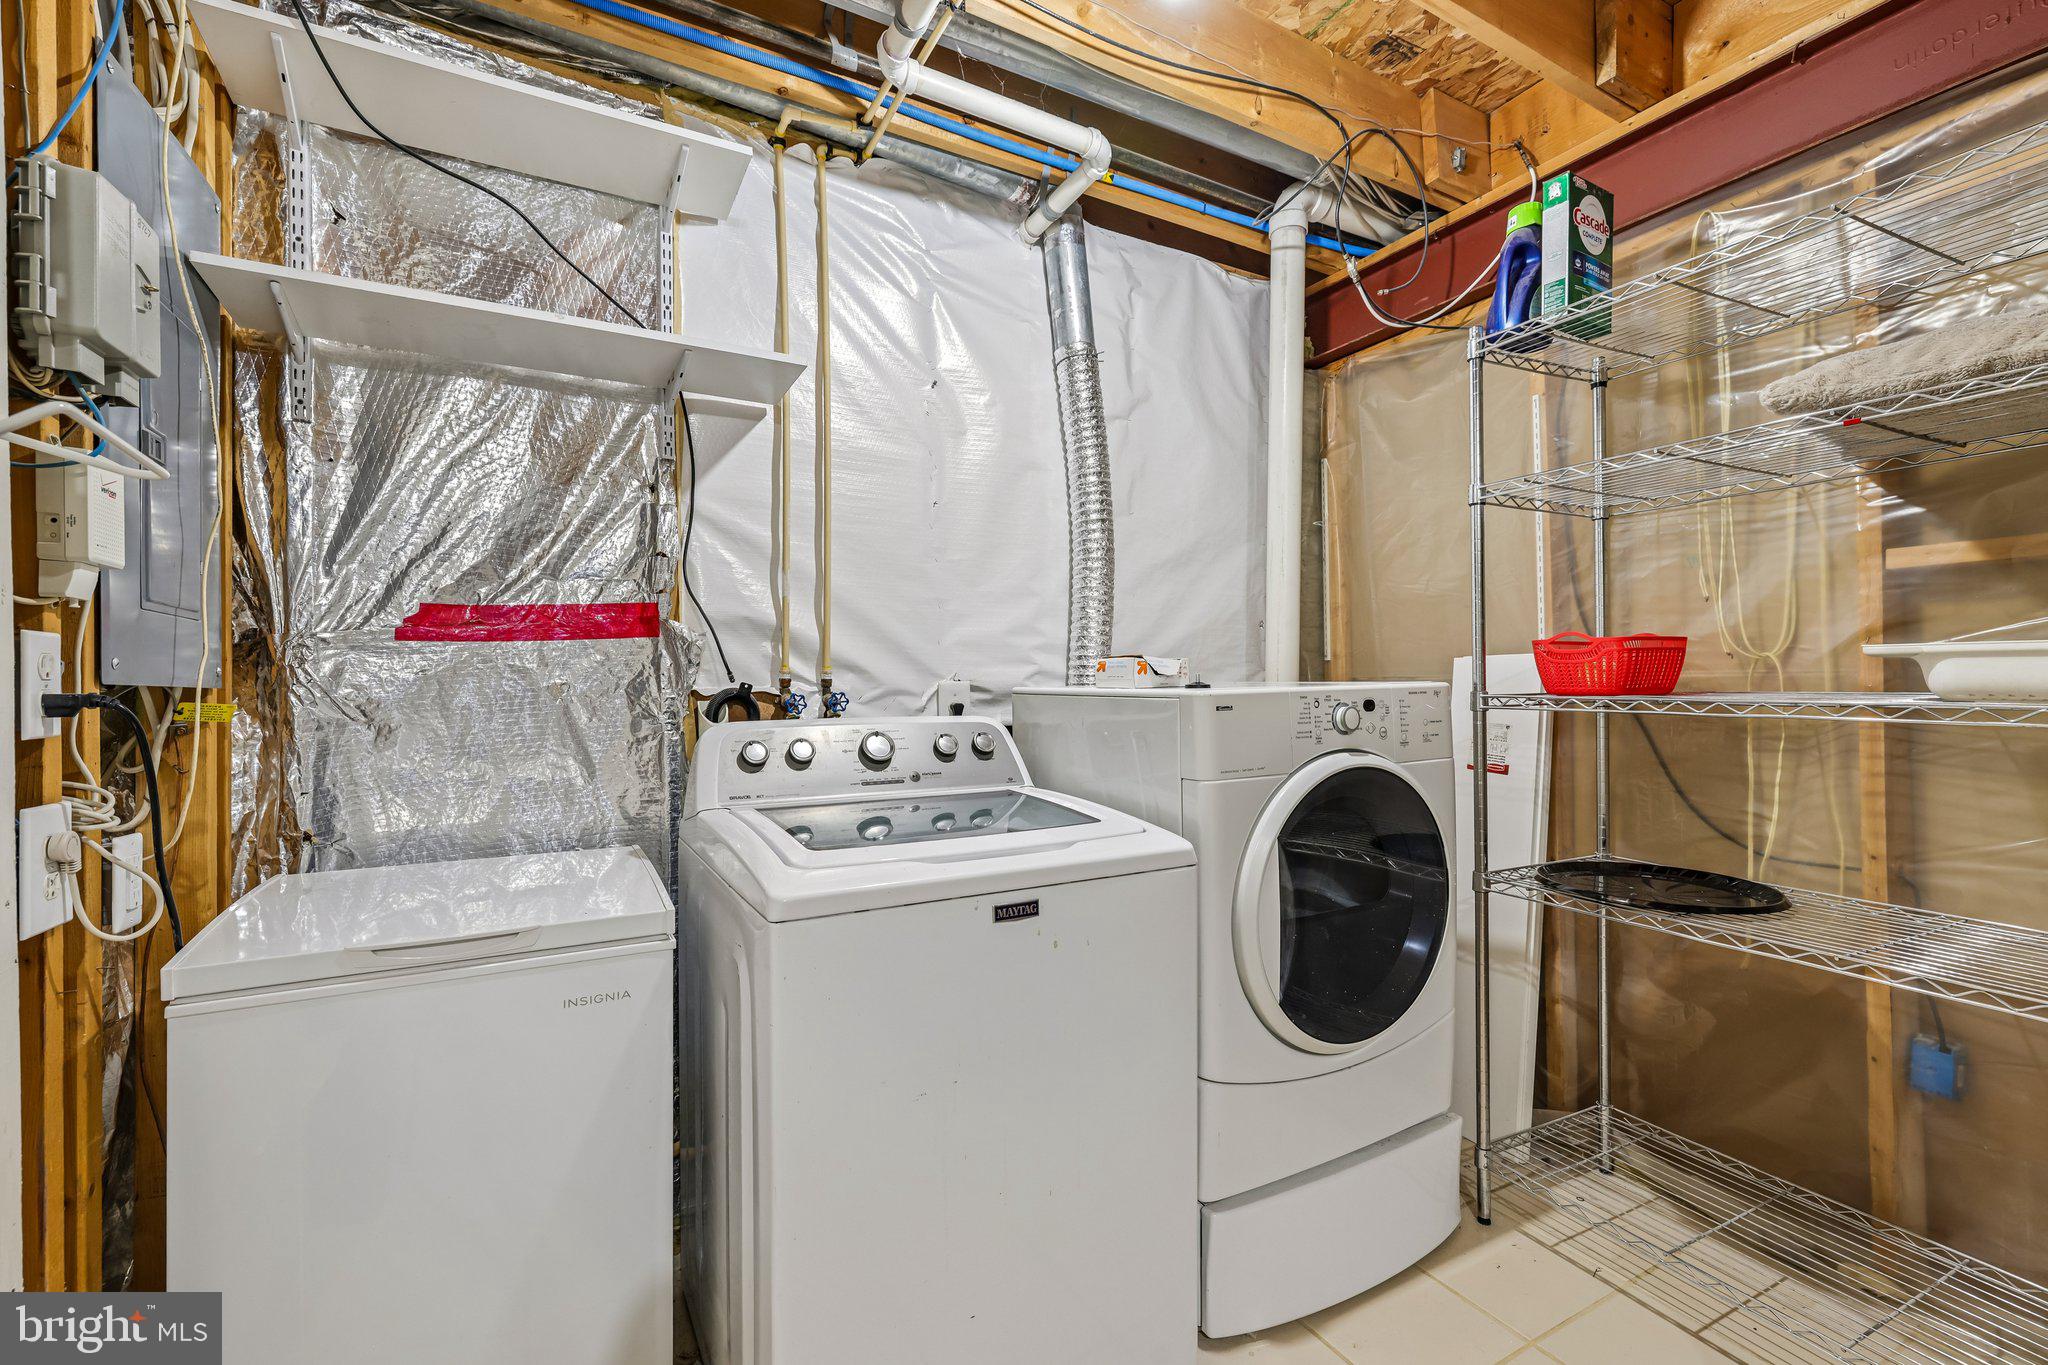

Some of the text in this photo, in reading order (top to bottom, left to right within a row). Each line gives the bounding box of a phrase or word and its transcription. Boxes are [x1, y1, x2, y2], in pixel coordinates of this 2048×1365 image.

[1573, 207, 1610, 237] Cascade
[1582, 229, 1603, 245] COMPLETE
[996, 903, 1038, 919] MAYTAG
[563, 990, 632, 1009] INSIGNIA
